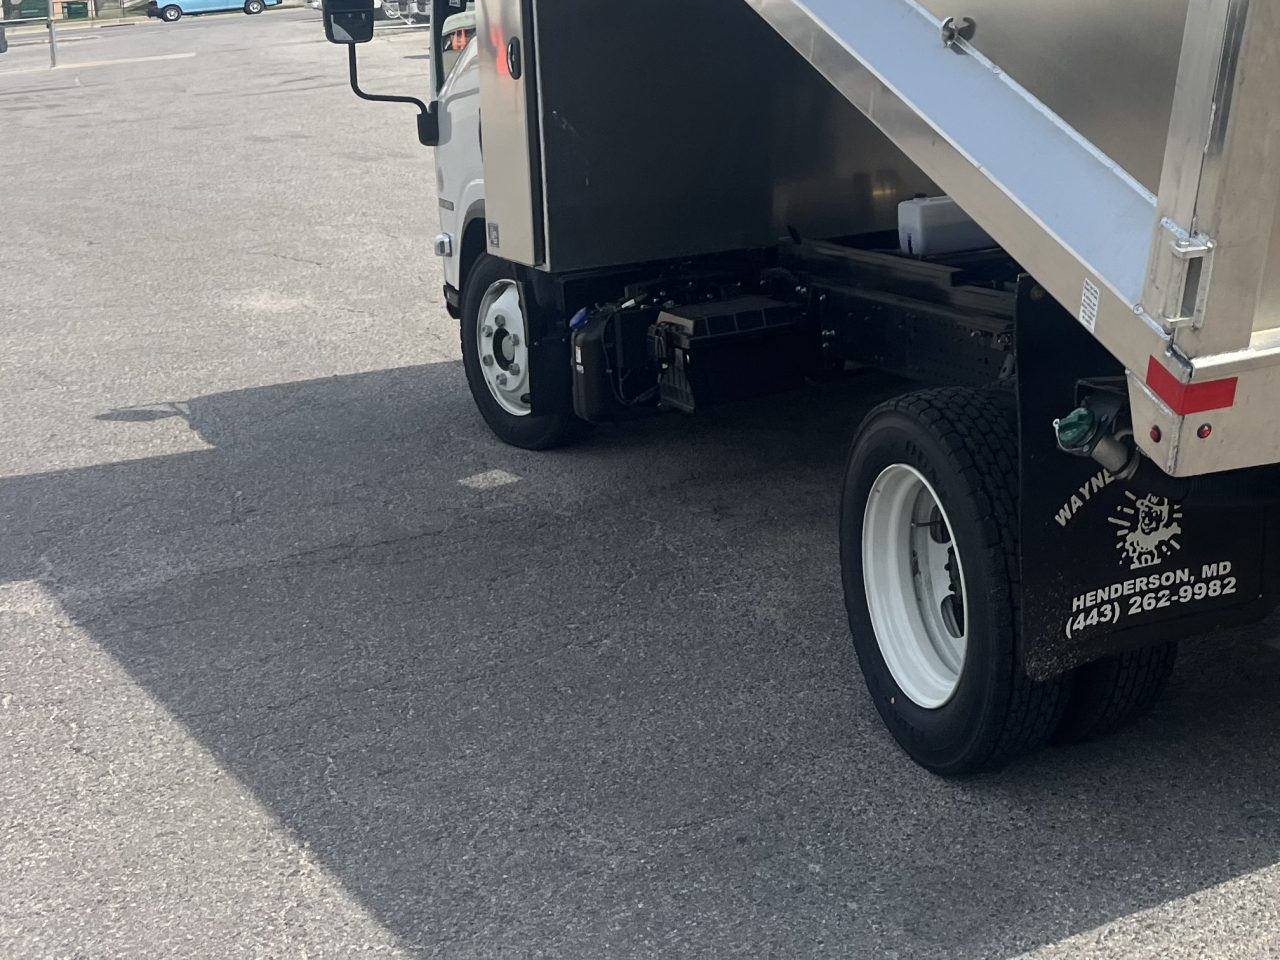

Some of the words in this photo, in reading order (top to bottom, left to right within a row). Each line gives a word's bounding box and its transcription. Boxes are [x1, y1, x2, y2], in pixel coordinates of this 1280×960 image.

[1065, 601, 1121, 639] (443)
[1127, 576, 1237, 616] 262-9982
[1072, 567, 1195, 613] HENDERSON,
[1201, 560, 1232, 580] MD
